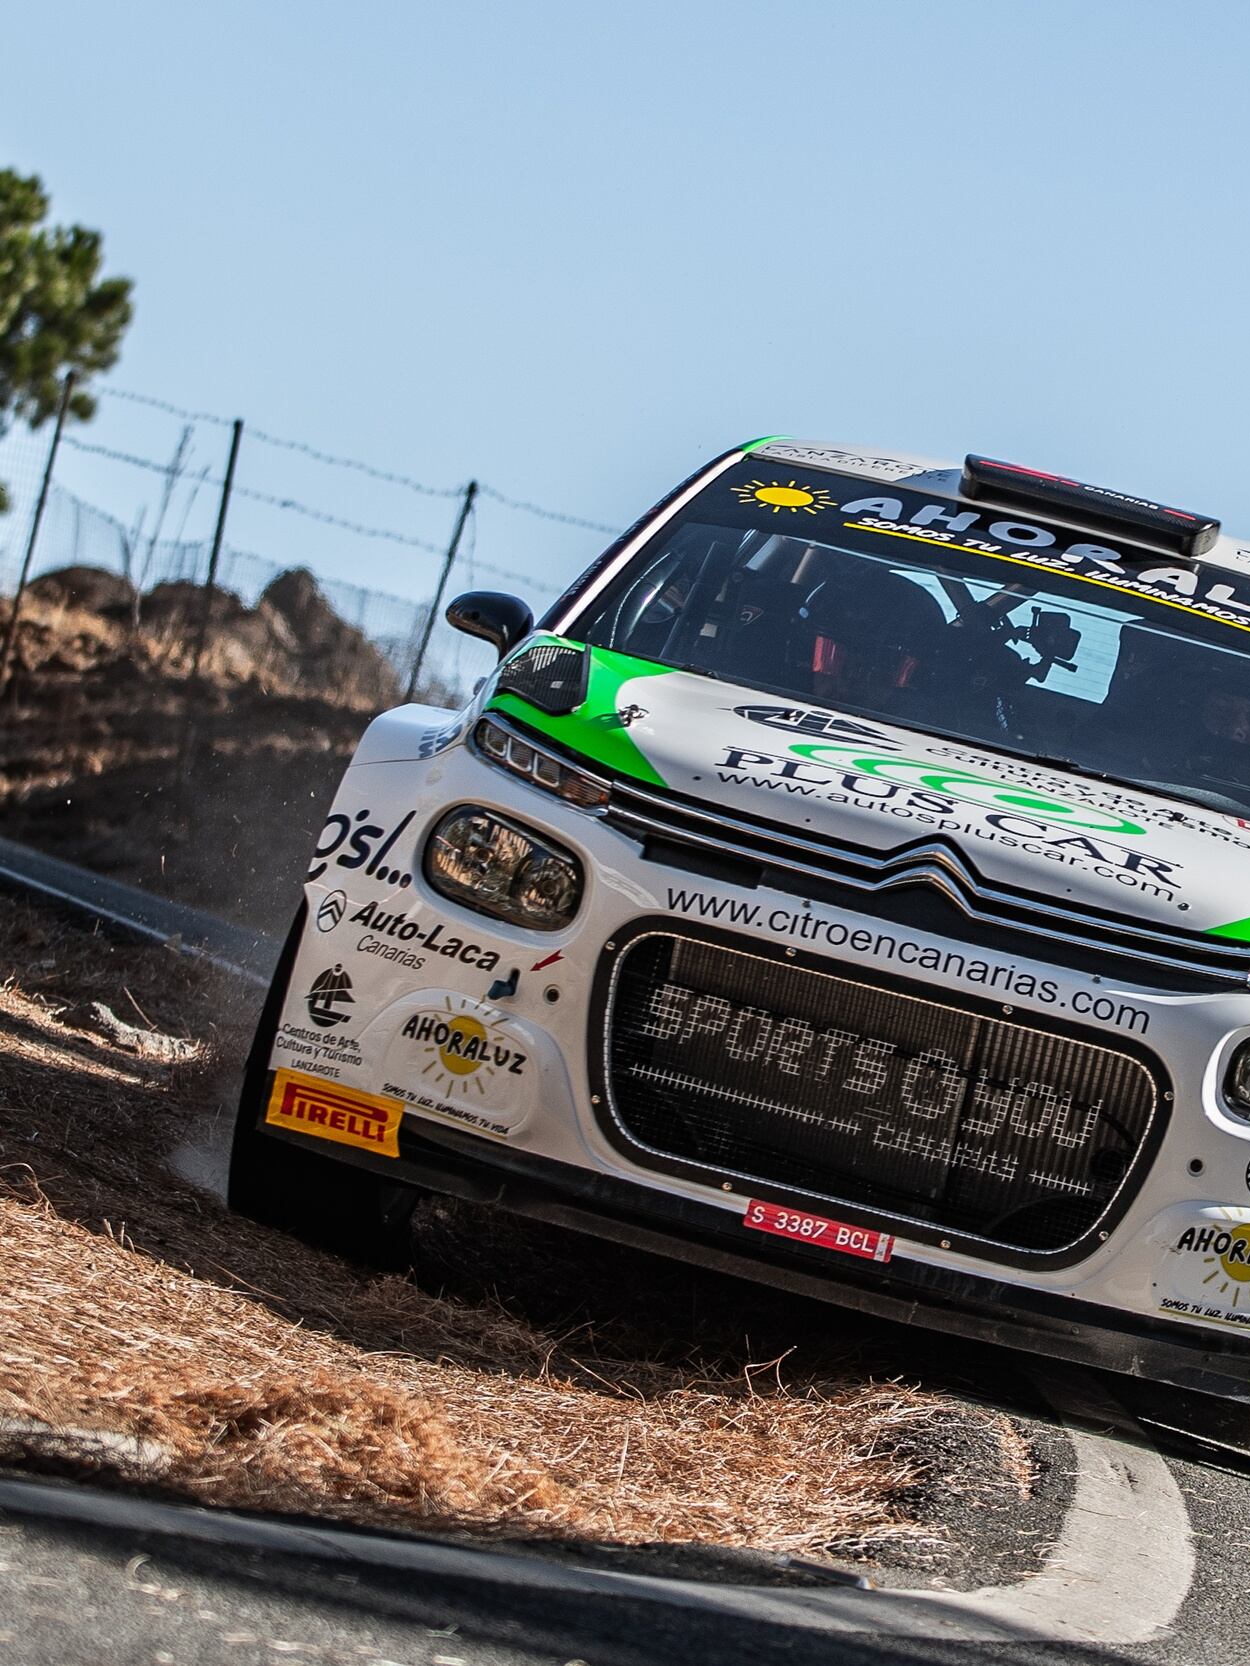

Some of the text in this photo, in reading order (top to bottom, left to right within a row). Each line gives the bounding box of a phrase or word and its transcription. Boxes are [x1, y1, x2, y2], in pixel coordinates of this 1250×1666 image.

[1084, 485, 1159, 510] CANARIAS
[857, 516, 955, 542] SOMOS
[963, 538, 1002, 552] TU
[715, 749, 1182, 889] PLUS CAR
[1000, 774, 1174, 831] LANZAROTE
[717, 772, 1174, 901] www.autospluscar.com
[349, 901, 501, 972] Auto-Laca
[356, 935, 426, 970] Canarias
[667, 888, 1151, 1034] www.citroencanarias.com
[276, 1036, 362, 1066] Cultura y Turismo
[281, 1023, 321, 1041] Centros
[323, 1033, 337, 1045] de
[402, 1015, 527, 1074] AHORALUZ
[641, 983, 898, 1094] SPORTS
[291, 1059, 340, 1078] LANZAROTE
[279, 1082, 389, 1143] PIRELLI
[751, 1206, 765, 1223] S
[774, 1212, 828, 1239] 3387
[835, 1227, 874, 1253] BCL
[1160, 1298, 1189, 1312] SOMOS
[1190, 1305, 1201, 1314] TU
